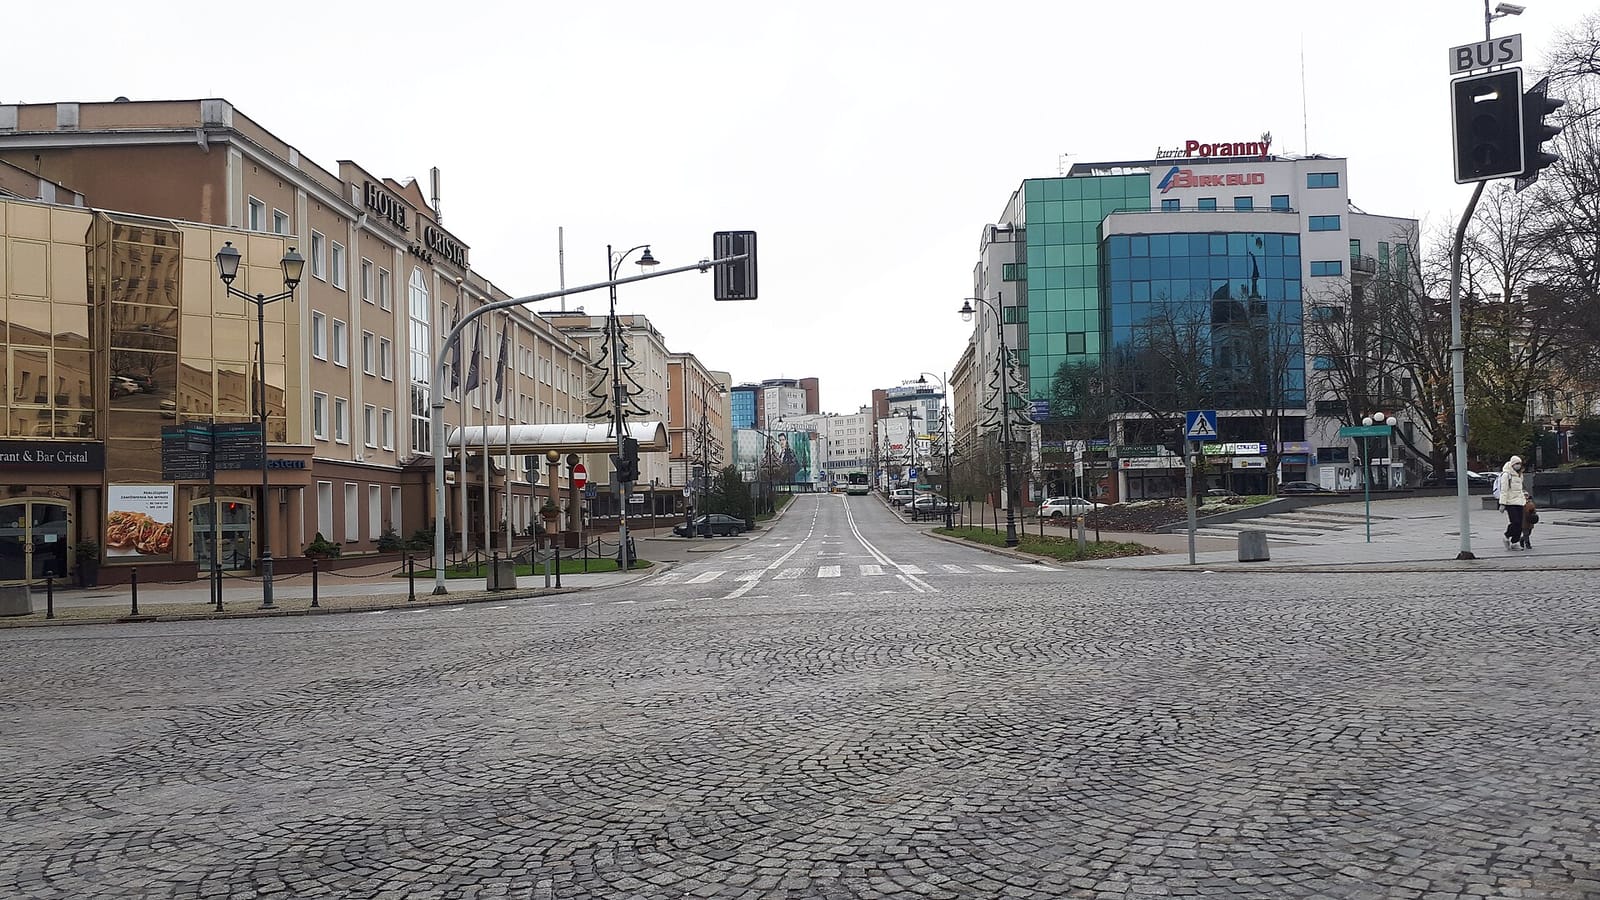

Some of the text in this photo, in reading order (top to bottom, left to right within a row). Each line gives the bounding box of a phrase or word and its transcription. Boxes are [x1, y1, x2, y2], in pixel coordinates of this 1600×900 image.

[1456, 38, 1514, 71] BUS
[1185, 140, 1270, 161] Poranny
[364, 180, 410, 232] HOTEL
[424, 226, 470, 270] CRISTAL
[22, 450, 33, 462] &
[36, 450, 55, 462] Bar
[57, 450, 88, 463] Cristal
